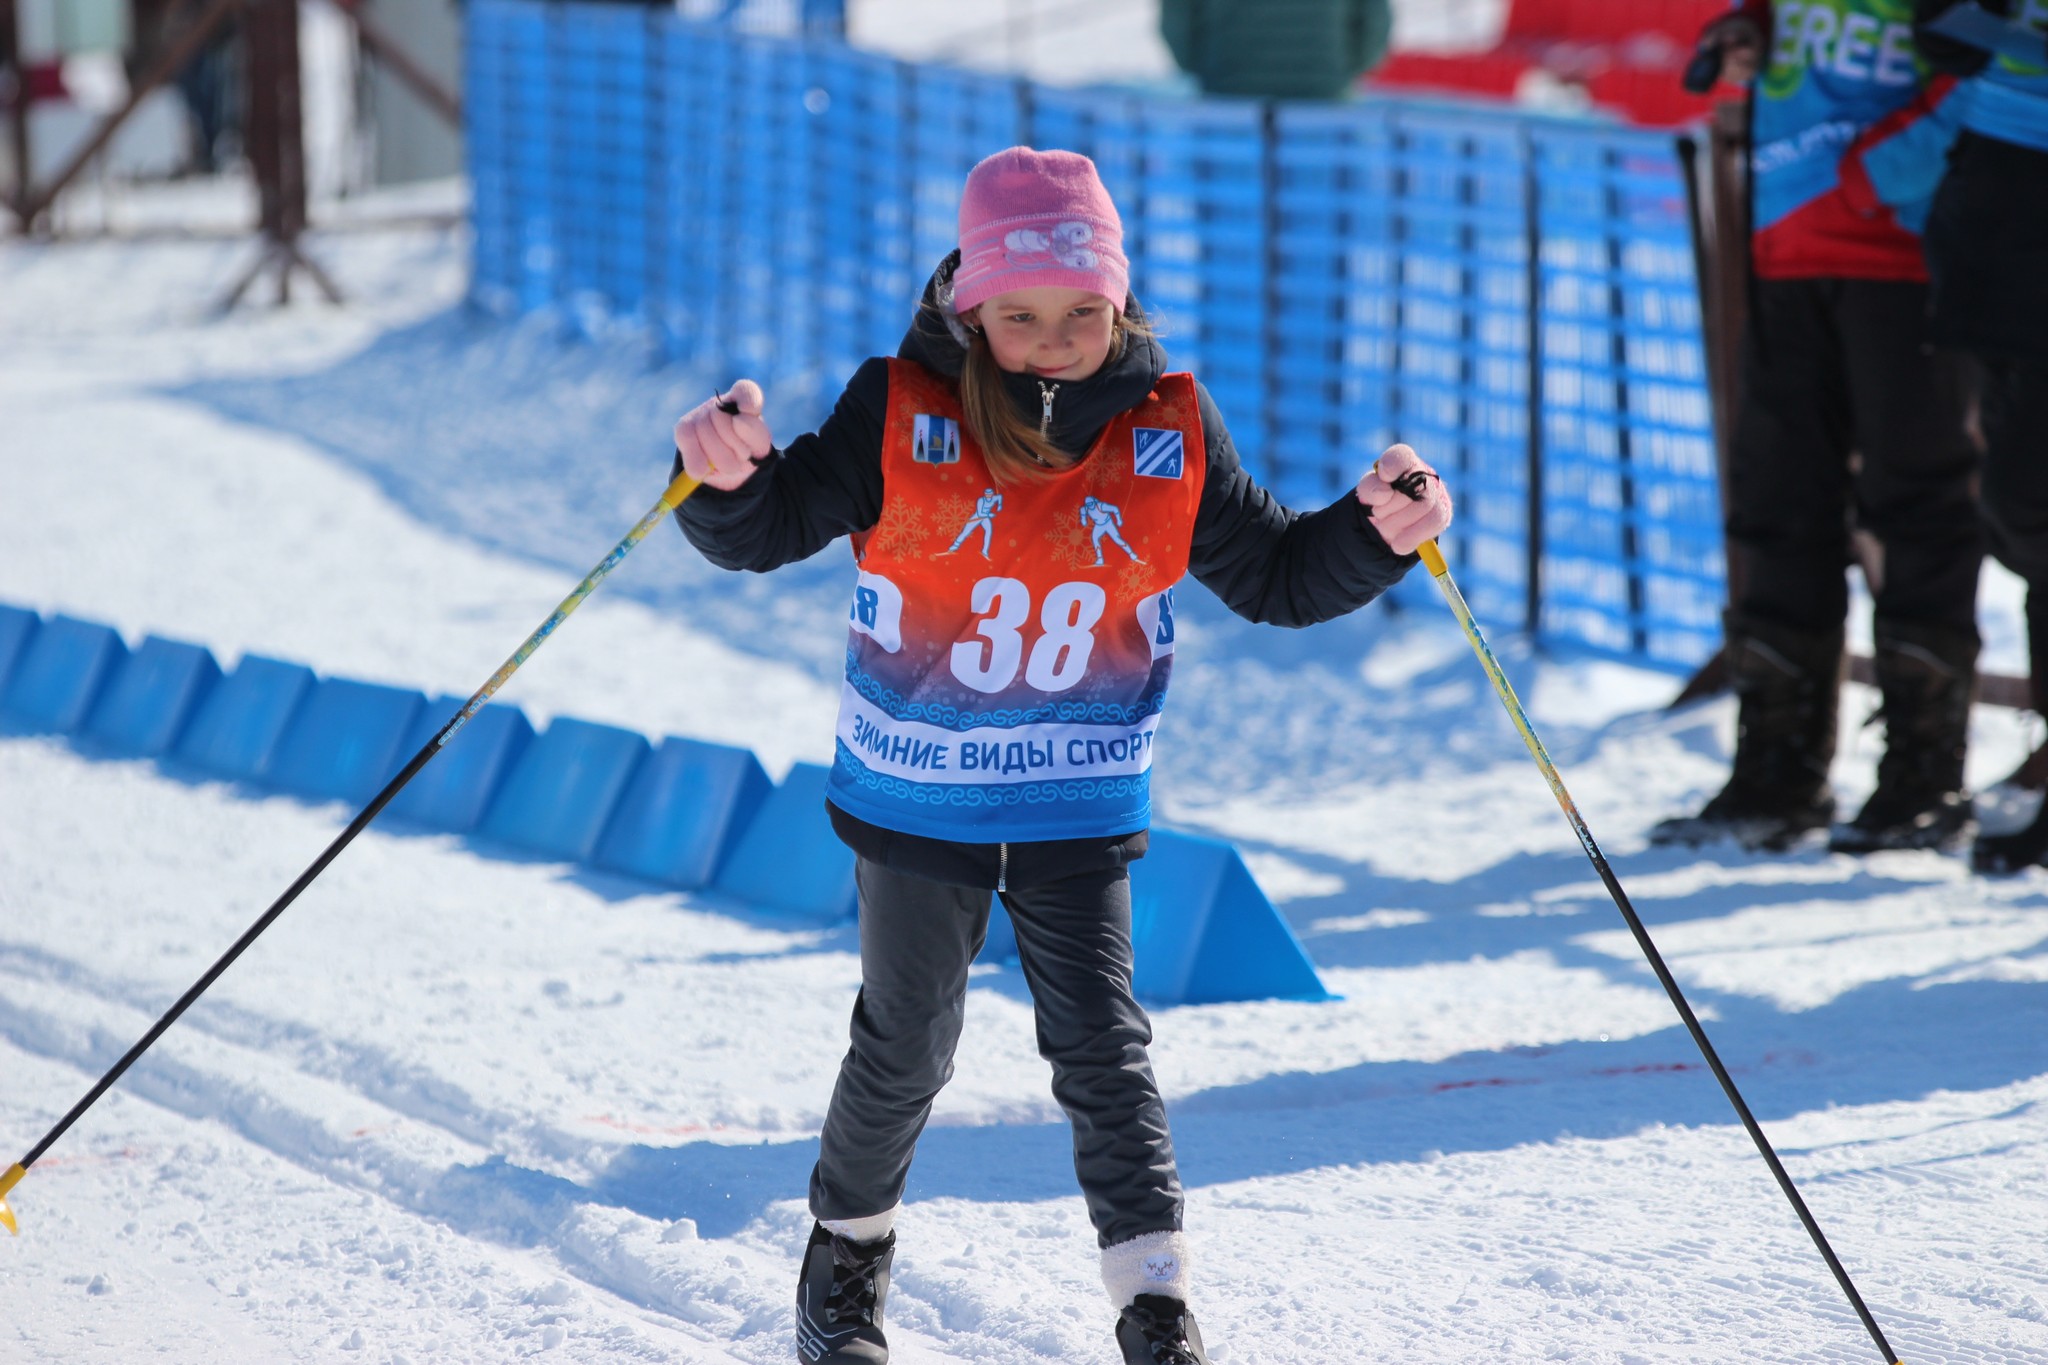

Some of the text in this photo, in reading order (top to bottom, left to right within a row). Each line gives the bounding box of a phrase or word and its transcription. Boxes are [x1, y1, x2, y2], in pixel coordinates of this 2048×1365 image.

[850, 585, 878, 630] 8
[950, 576, 1106, 693] 38
[852, 714, 949, 770] ЗИМНИЕ
[960, 740, 1054, 775] ВИДЫ
